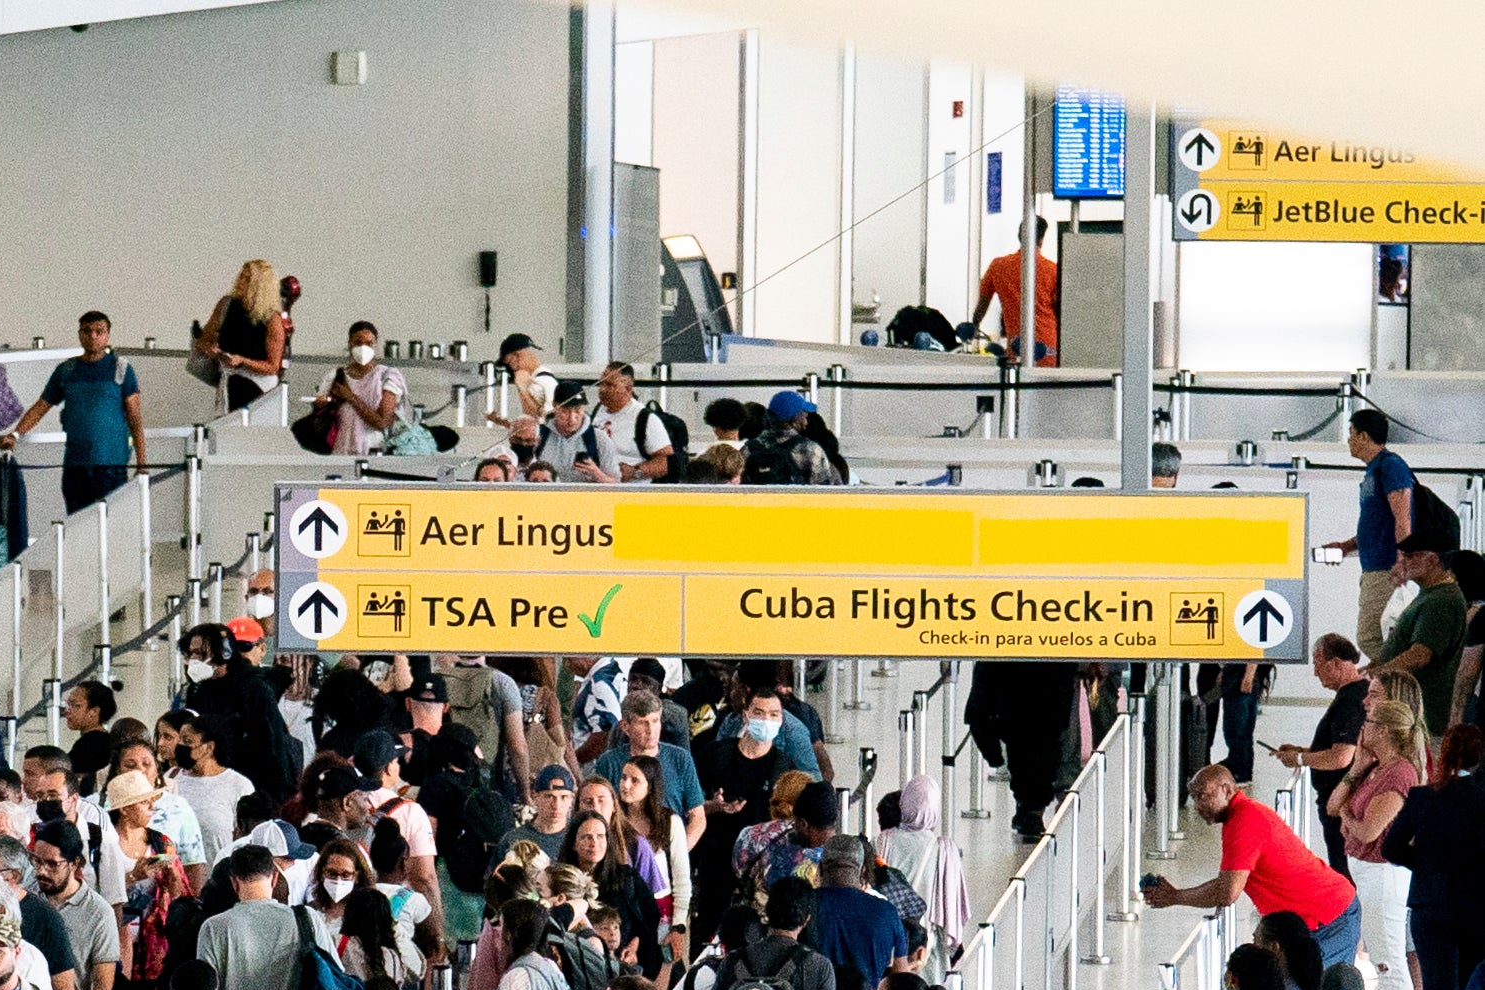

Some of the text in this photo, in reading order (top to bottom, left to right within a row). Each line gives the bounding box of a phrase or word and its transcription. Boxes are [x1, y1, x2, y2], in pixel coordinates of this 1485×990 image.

[1273, 139, 1417, 169] Aer Lingus
[1272, 200, 1376, 225] JetBlue
[420, 514, 614, 554] Aer Lingus
[421, 596, 569, 629] TSA Pre
[740, 588, 1154, 629] Cuba Flights Check-in
[919, 630, 1157, 650] Check-in para vuelos a Cuba
